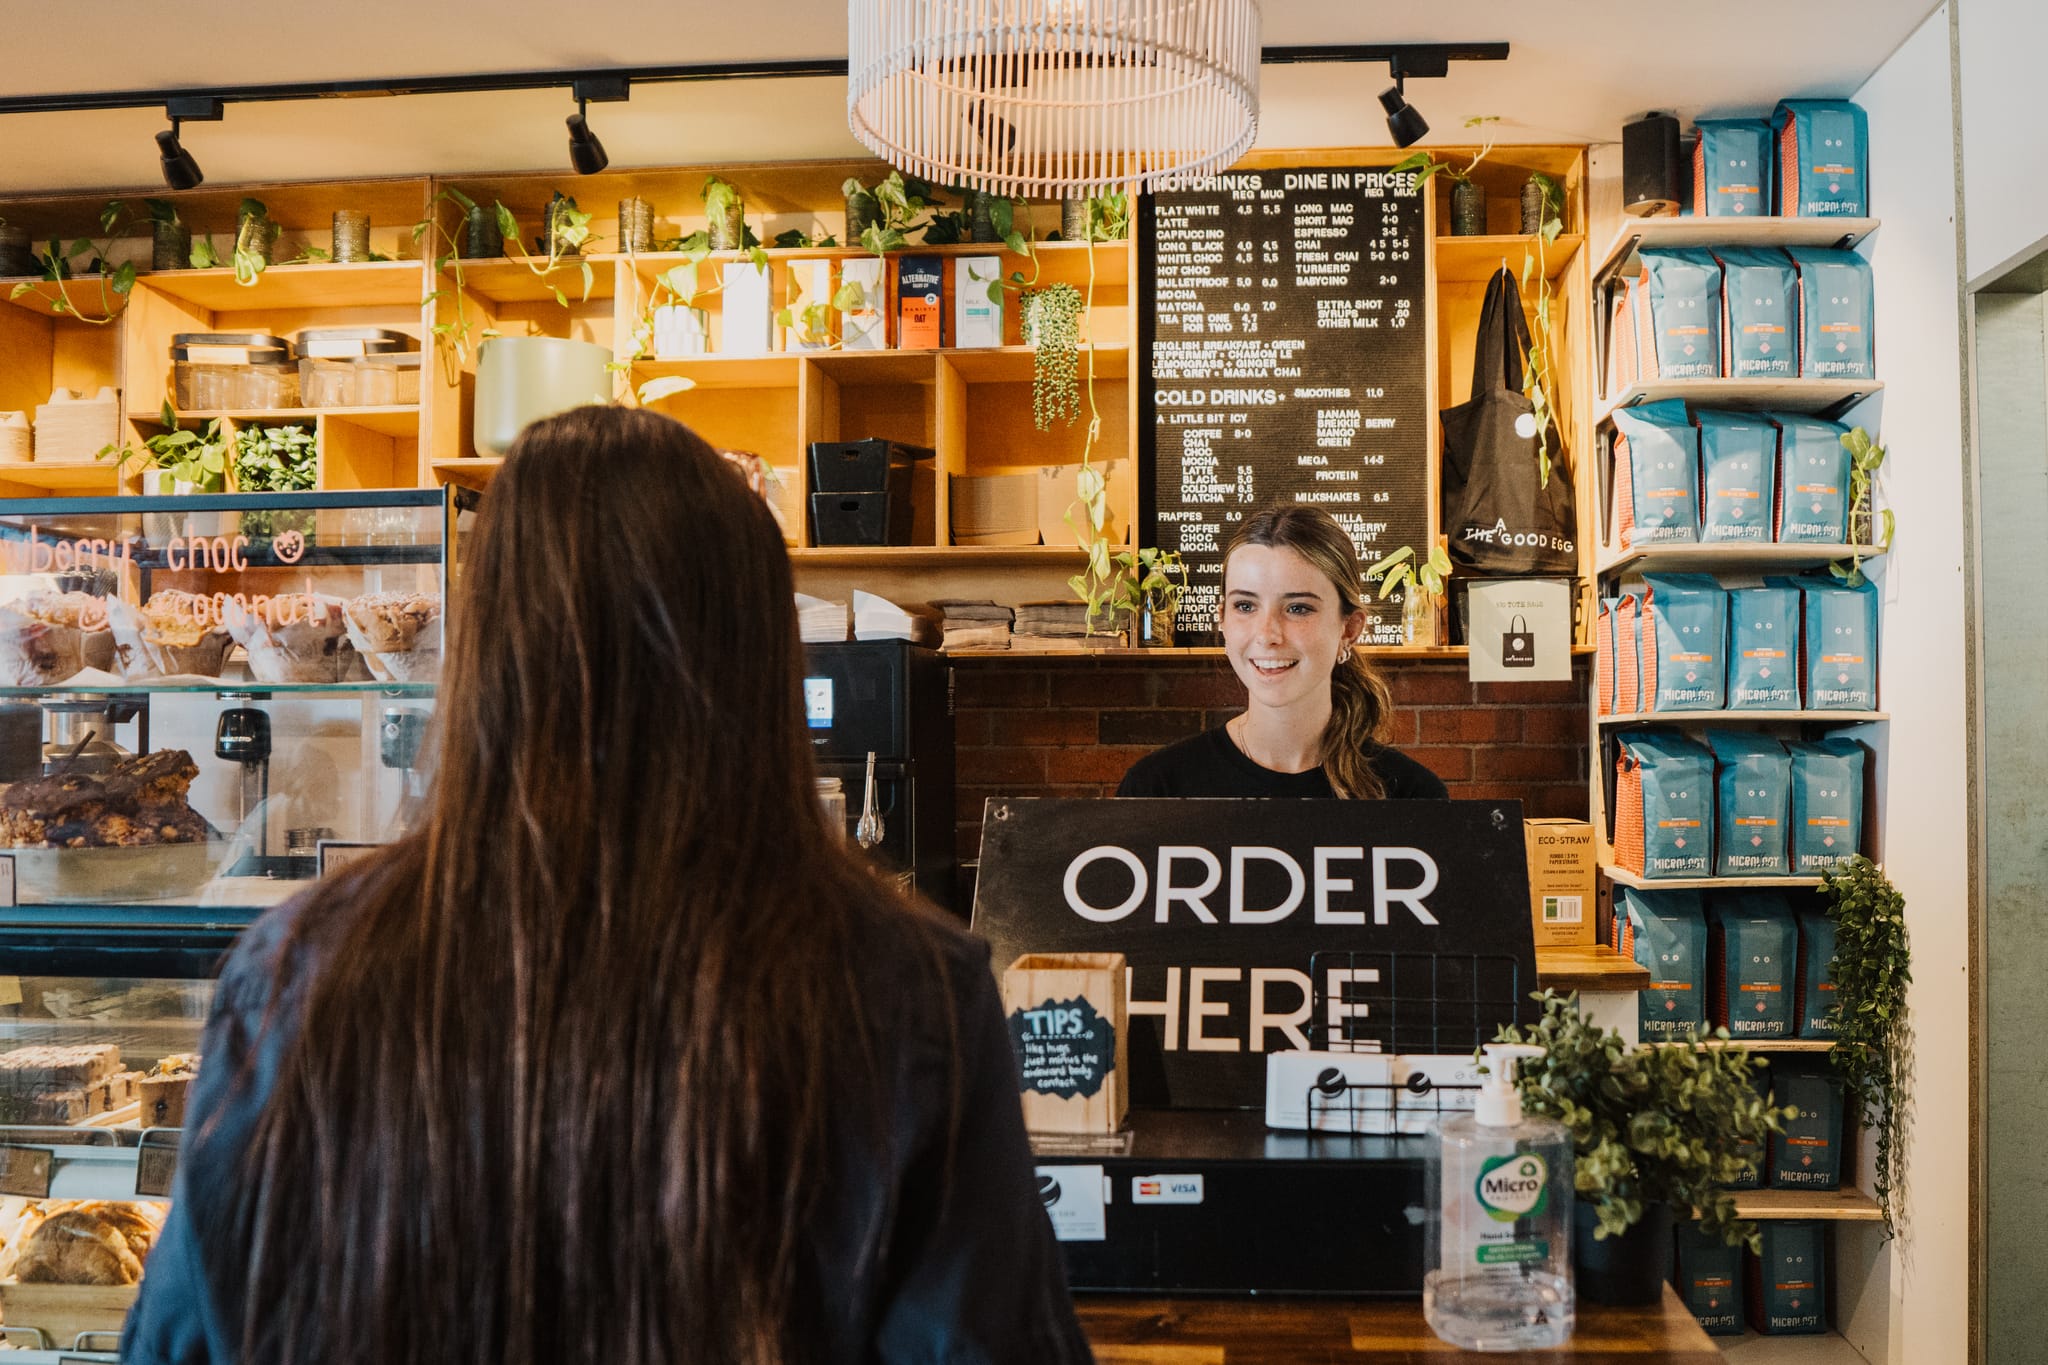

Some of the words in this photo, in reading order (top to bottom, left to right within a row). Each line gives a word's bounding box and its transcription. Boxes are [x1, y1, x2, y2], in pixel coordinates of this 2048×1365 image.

[1193, 175, 1262, 192] DRINKS
[1284, 174, 1328, 190] DINE
[1332, 174, 1350, 189] IN
[1354, 172, 1417, 189] PRICES
[1232, 190, 1255, 200] REG
[1260, 190, 1284, 199] MUG
[1365, 188, 1384, 198] REG
[1394, 188, 1417, 198] MUG
[1155, 206, 1182, 216] FLAT
[1185, 205, 1220, 216] WHITE
[1237, 205, 1253, 216] 4.5
[1263, 204, 1281, 216] 5.5
[1294, 204, 1323, 214] LONG
[1330, 204, 1354, 213] MAC
[1382, 203, 1398, 214] 5.0
[1156, 218, 1189, 228] LATTE
[1294, 216, 1327, 226] SHORT
[1332, 216, 1354, 226] MAC
[1294, 228, 1348, 238] ESPRESSO
[1158, 242, 1187, 252] LONG
[1192, 242, 1224, 252] BLACK
[1237, 241, 1252, 252] 4.0
[1262, 240, 1278, 252] 4.5
[1294, 240, 1321, 250] CHAI
[1157, 254, 1192, 264] WHITE
[1193, 254, 1223, 264] CHOC
[1236, 253, 1253, 264] 4.5
[1263, 252, 1279, 264] 5.5
[1296, 252, 1328, 261] FRESH
[1334, 252, 1360, 261] CHAI
[1157, 266, 1178, 276] HOT
[1180, 266, 1211, 276] CHOC
[1296, 264, 1350, 274] TURMERIC
[1157, 277, 1229, 288] BULLETPROOF
[1236, 276, 1252, 288] 5.0
[1296, 276, 1348, 286] BABYCINO
[1156, 290, 1197, 300] MOCHA
[1156, 302, 1205, 312] MATCHA
[1317, 300, 1352, 310] EXTRA
[1354, 300, 1383, 310] SHOT
[1158, 314, 1178, 324] TEA
[1182, 314, 1203, 323] FOR
[1208, 313, 1230, 322] ONE
[1318, 309, 1358, 318] SYRUPS
[1183, 323, 1204, 332] FOR
[1208, 322, 1232, 332] TWO
[1318, 318, 1350, 328] OTHER
[1353, 318, 1378, 328] MILK
[1152, 341, 1200, 350] ENGLISH
[1204, 340, 1262, 350] BREAKFAST
[1272, 340, 1306, 350] GREEN
[1153, 350, 1217, 360] PEPPERMINT
[1152, 359, 1224, 369] LEMONGRASS
[1236, 358, 1276, 368] GINGER
[1152, 368, 1179, 378] EARL
[1183, 368, 1211, 378] GREY
[1224, 368, 1268, 378] MASALA
[1274, 367, 1301, 377] CHAI
[1154, 389, 1206, 405] COLD
[1210, 389, 1277, 405] DRINKS
[1294, 388, 1351, 398] SMOOTHIES
[1156, 414, 1164, 424] A
[1170, 414, 1204, 424] LITTLE
[1206, 414, 1224, 424] BIT
[1230, 413, 1248, 424] ICY
[1318, 409, 1360, 419] BANANA
[1318, 418, 1360, 428] BREKKIE
[1366, 418, 1396, 428] BERRY
[1184, 428, 1222, 439] COFFEE
[1317, 428, 1356, 438] MANGO
[1183, 438, 1209, 448] CHAI
[1317, 437, 1351, 447] GREEN
[1184, 448, 1213, 457] CHOC
[1182, 456, 1219, 466] MOCHA
[1298, 456, 1329, 466] MEGA
[1182, 466, 1214, 476] LATTE
[1316, 470, 1358, 480] PROTEIN
[1182, 475, 1218, 484] BLACK
[1181, 484, 1208, 494] COLD
[1208, 484, 1236, 494] BREW
[1182, 494, 1224, 503] MATCHA
[1296, 492, 1360, 502] MILKSHAKES
[1158, 512, 1202, 522] FRAPPES
[1180, 524, 1220, 533] COFFEE
[1495, 518, 1506, 531] A
[1180, 534, 1213, 543] CHOC
[1501, 533, 1548, 548] GOOD
[1551, 537, 1574, 552] EGG
[1180, 542, 1219, 552] MOCHA
[0, 524, 131, 604] wberry
[167, 524, 249, 574] choc
[1177, 586, 1220, 595] ORANGE
[174, 577, 320, 628] coconut
[1177, 614, 1211, 622] HEART
[1177, 623, 1212, 632] GREEN
[1538, 836, 1590, 844] ECO-STRAW
[1063, 845, 1440, 926] ORDER
[1127, 966, 1381, 1053] HERE
[1023, 1008, 1084, 1036] TIPS
[1170, 1184, 1197, 1192] VISA
[1486, 1178, 1538, 1194] Micro
